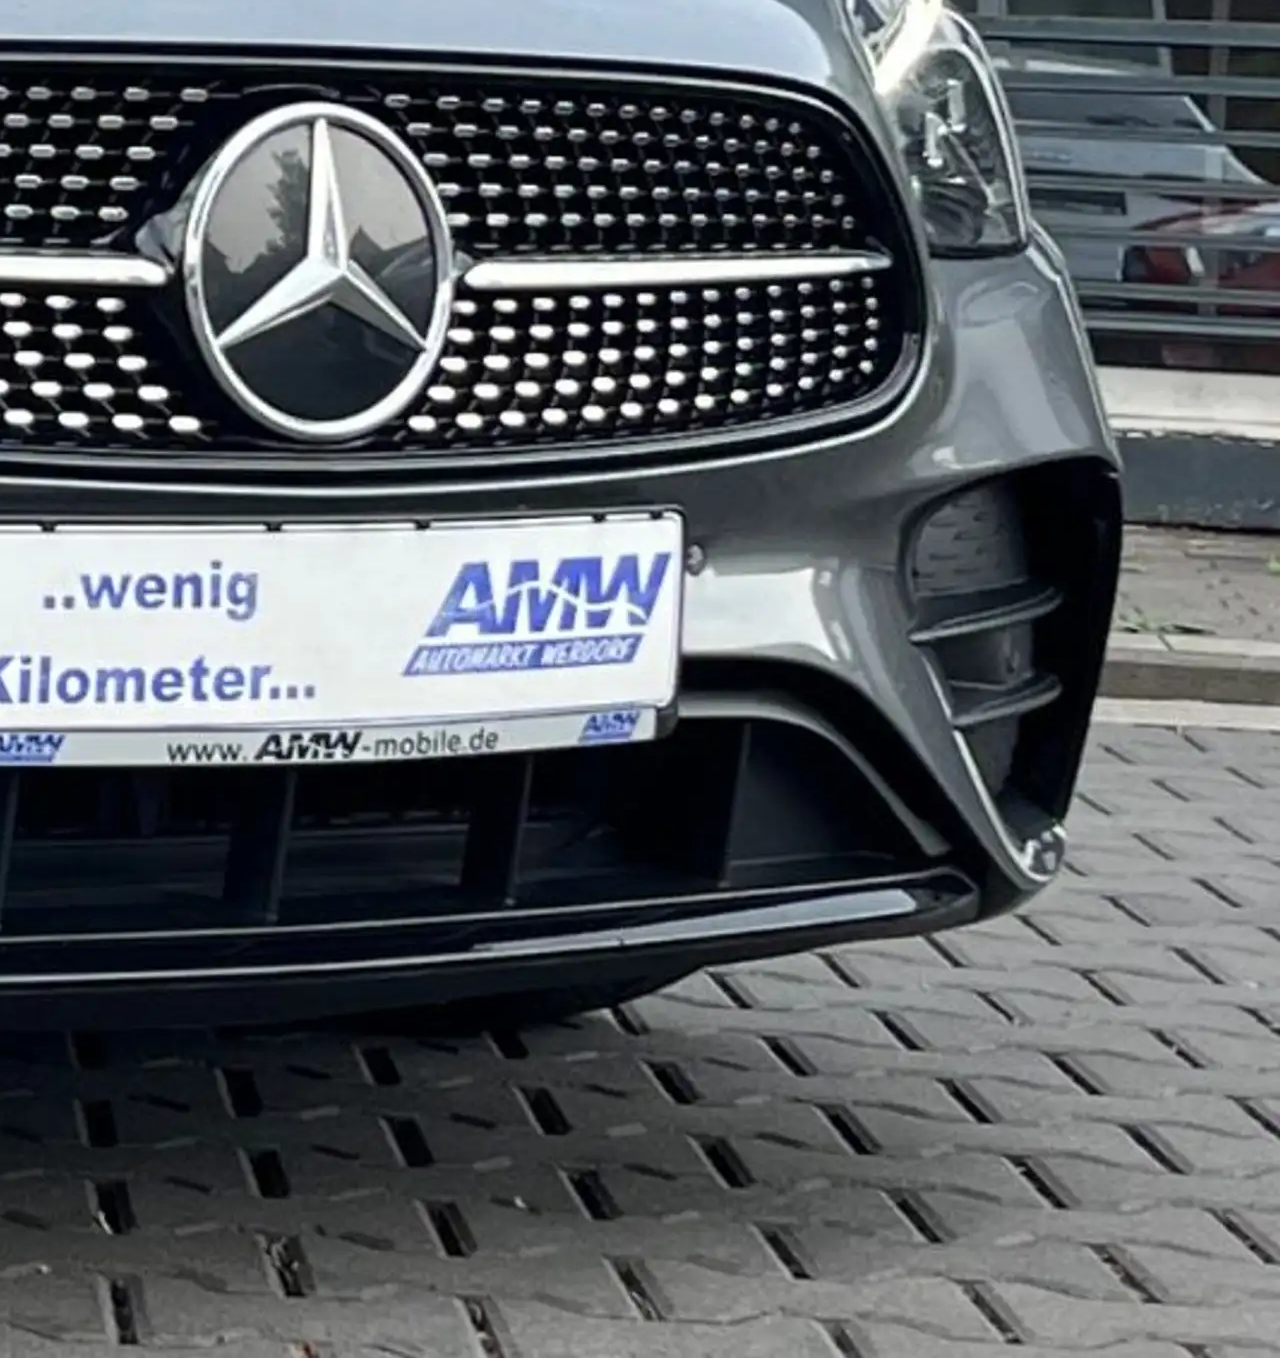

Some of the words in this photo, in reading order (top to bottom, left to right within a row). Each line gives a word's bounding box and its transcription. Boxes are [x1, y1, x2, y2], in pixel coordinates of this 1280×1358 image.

[42, 559, 259, 622] ..wenig
[424, 551, 672, 638] AMW
[410, 643, 538, 673] AUTOMARKT
[540, 636, 636, 666] WERDORF
[166, 726, 500, 763] www.AMW-mobile.de
